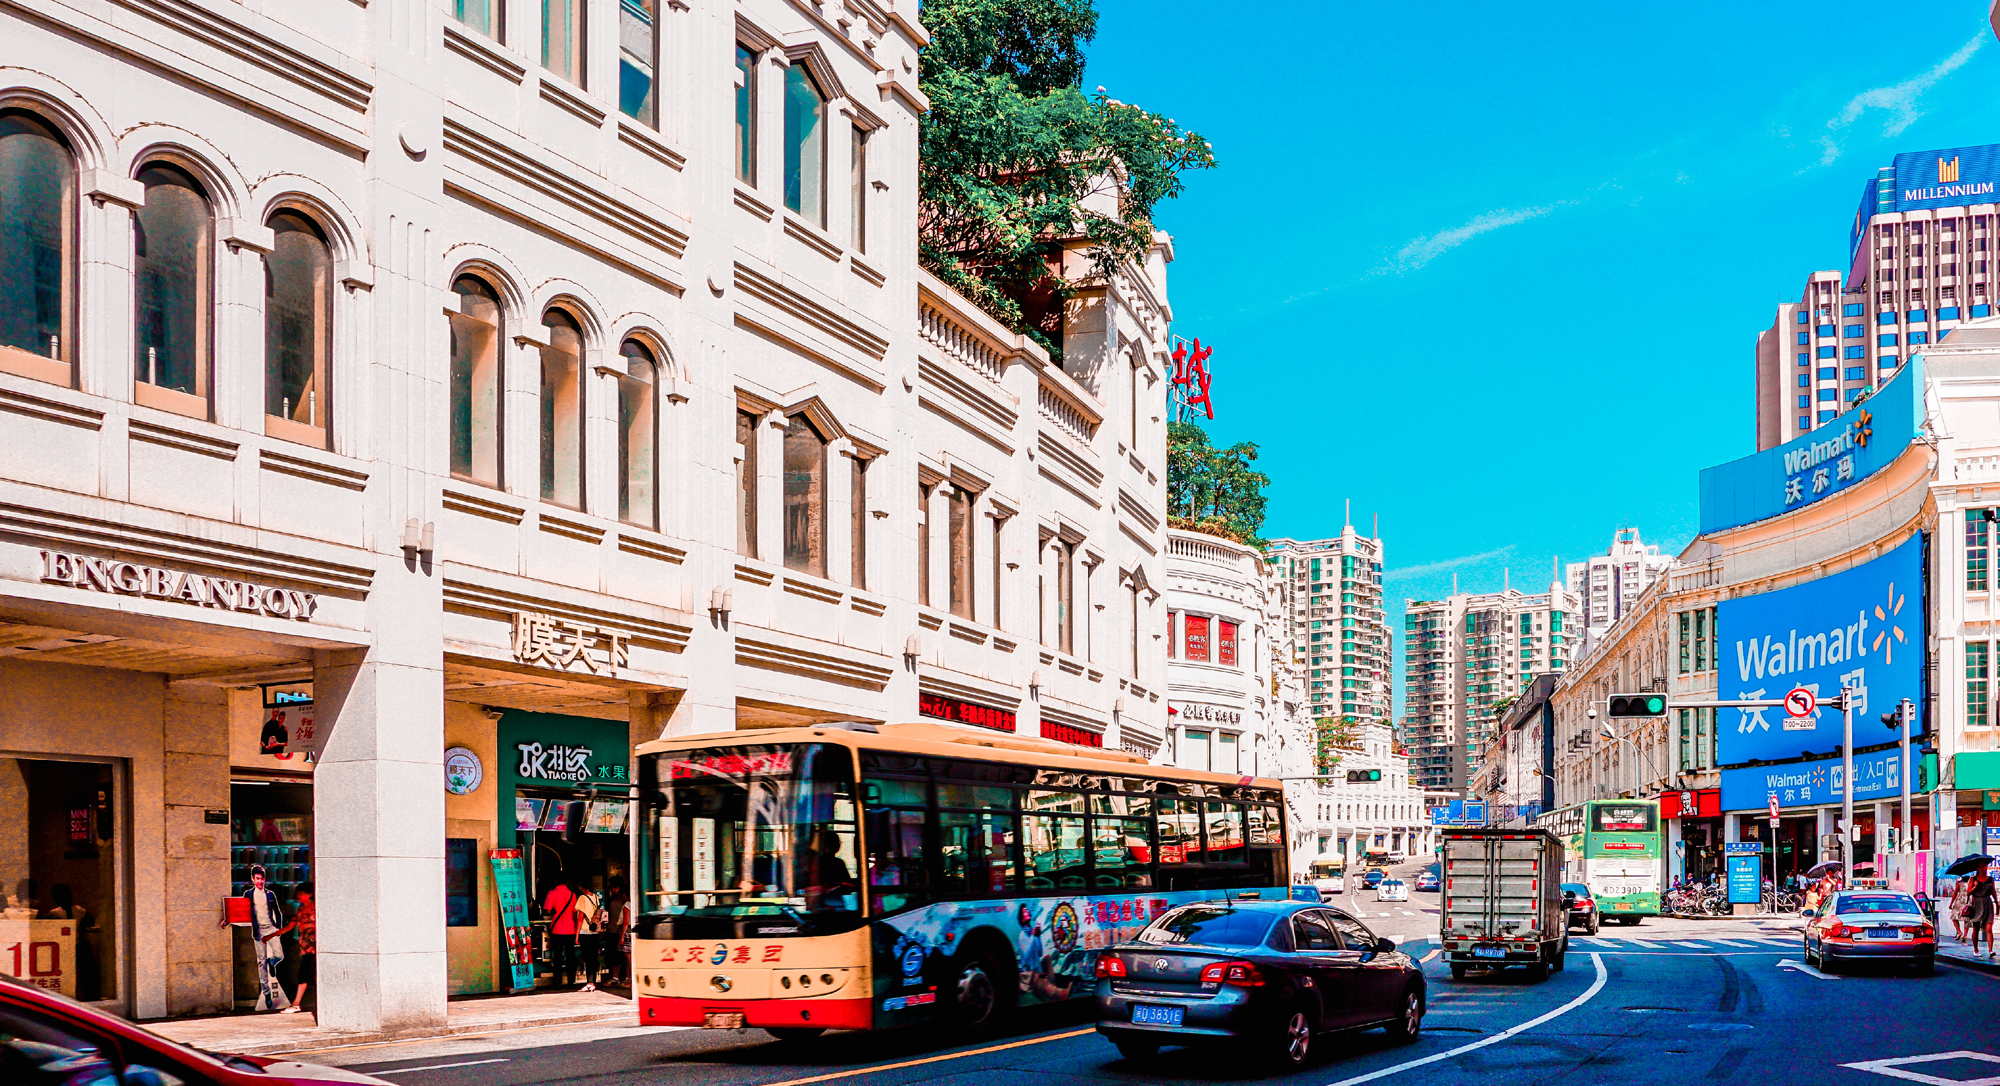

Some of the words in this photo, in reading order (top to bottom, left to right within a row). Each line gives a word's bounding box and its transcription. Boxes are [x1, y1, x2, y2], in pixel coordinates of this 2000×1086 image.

[1905, 182, 1994, 201] MILLENNIUM
[1172, 337, 1214, 420] 城
[1783, 423, 1855, 476] Walmart
[1784, 453, 1855, 505] 沃尔玛
[40, 550, 318, 622] ENGBANBOY
[513, 611, 632, 675] 膜天下
[1736, 609, 1868, 682] Walmart
[449, 764, 474, 776] 膜天下
[598, 765, 631, 780] 水果
[1767, 771, 1811, 788] Walmart
[1767, 787, 1811, 803] 沃尔玛
